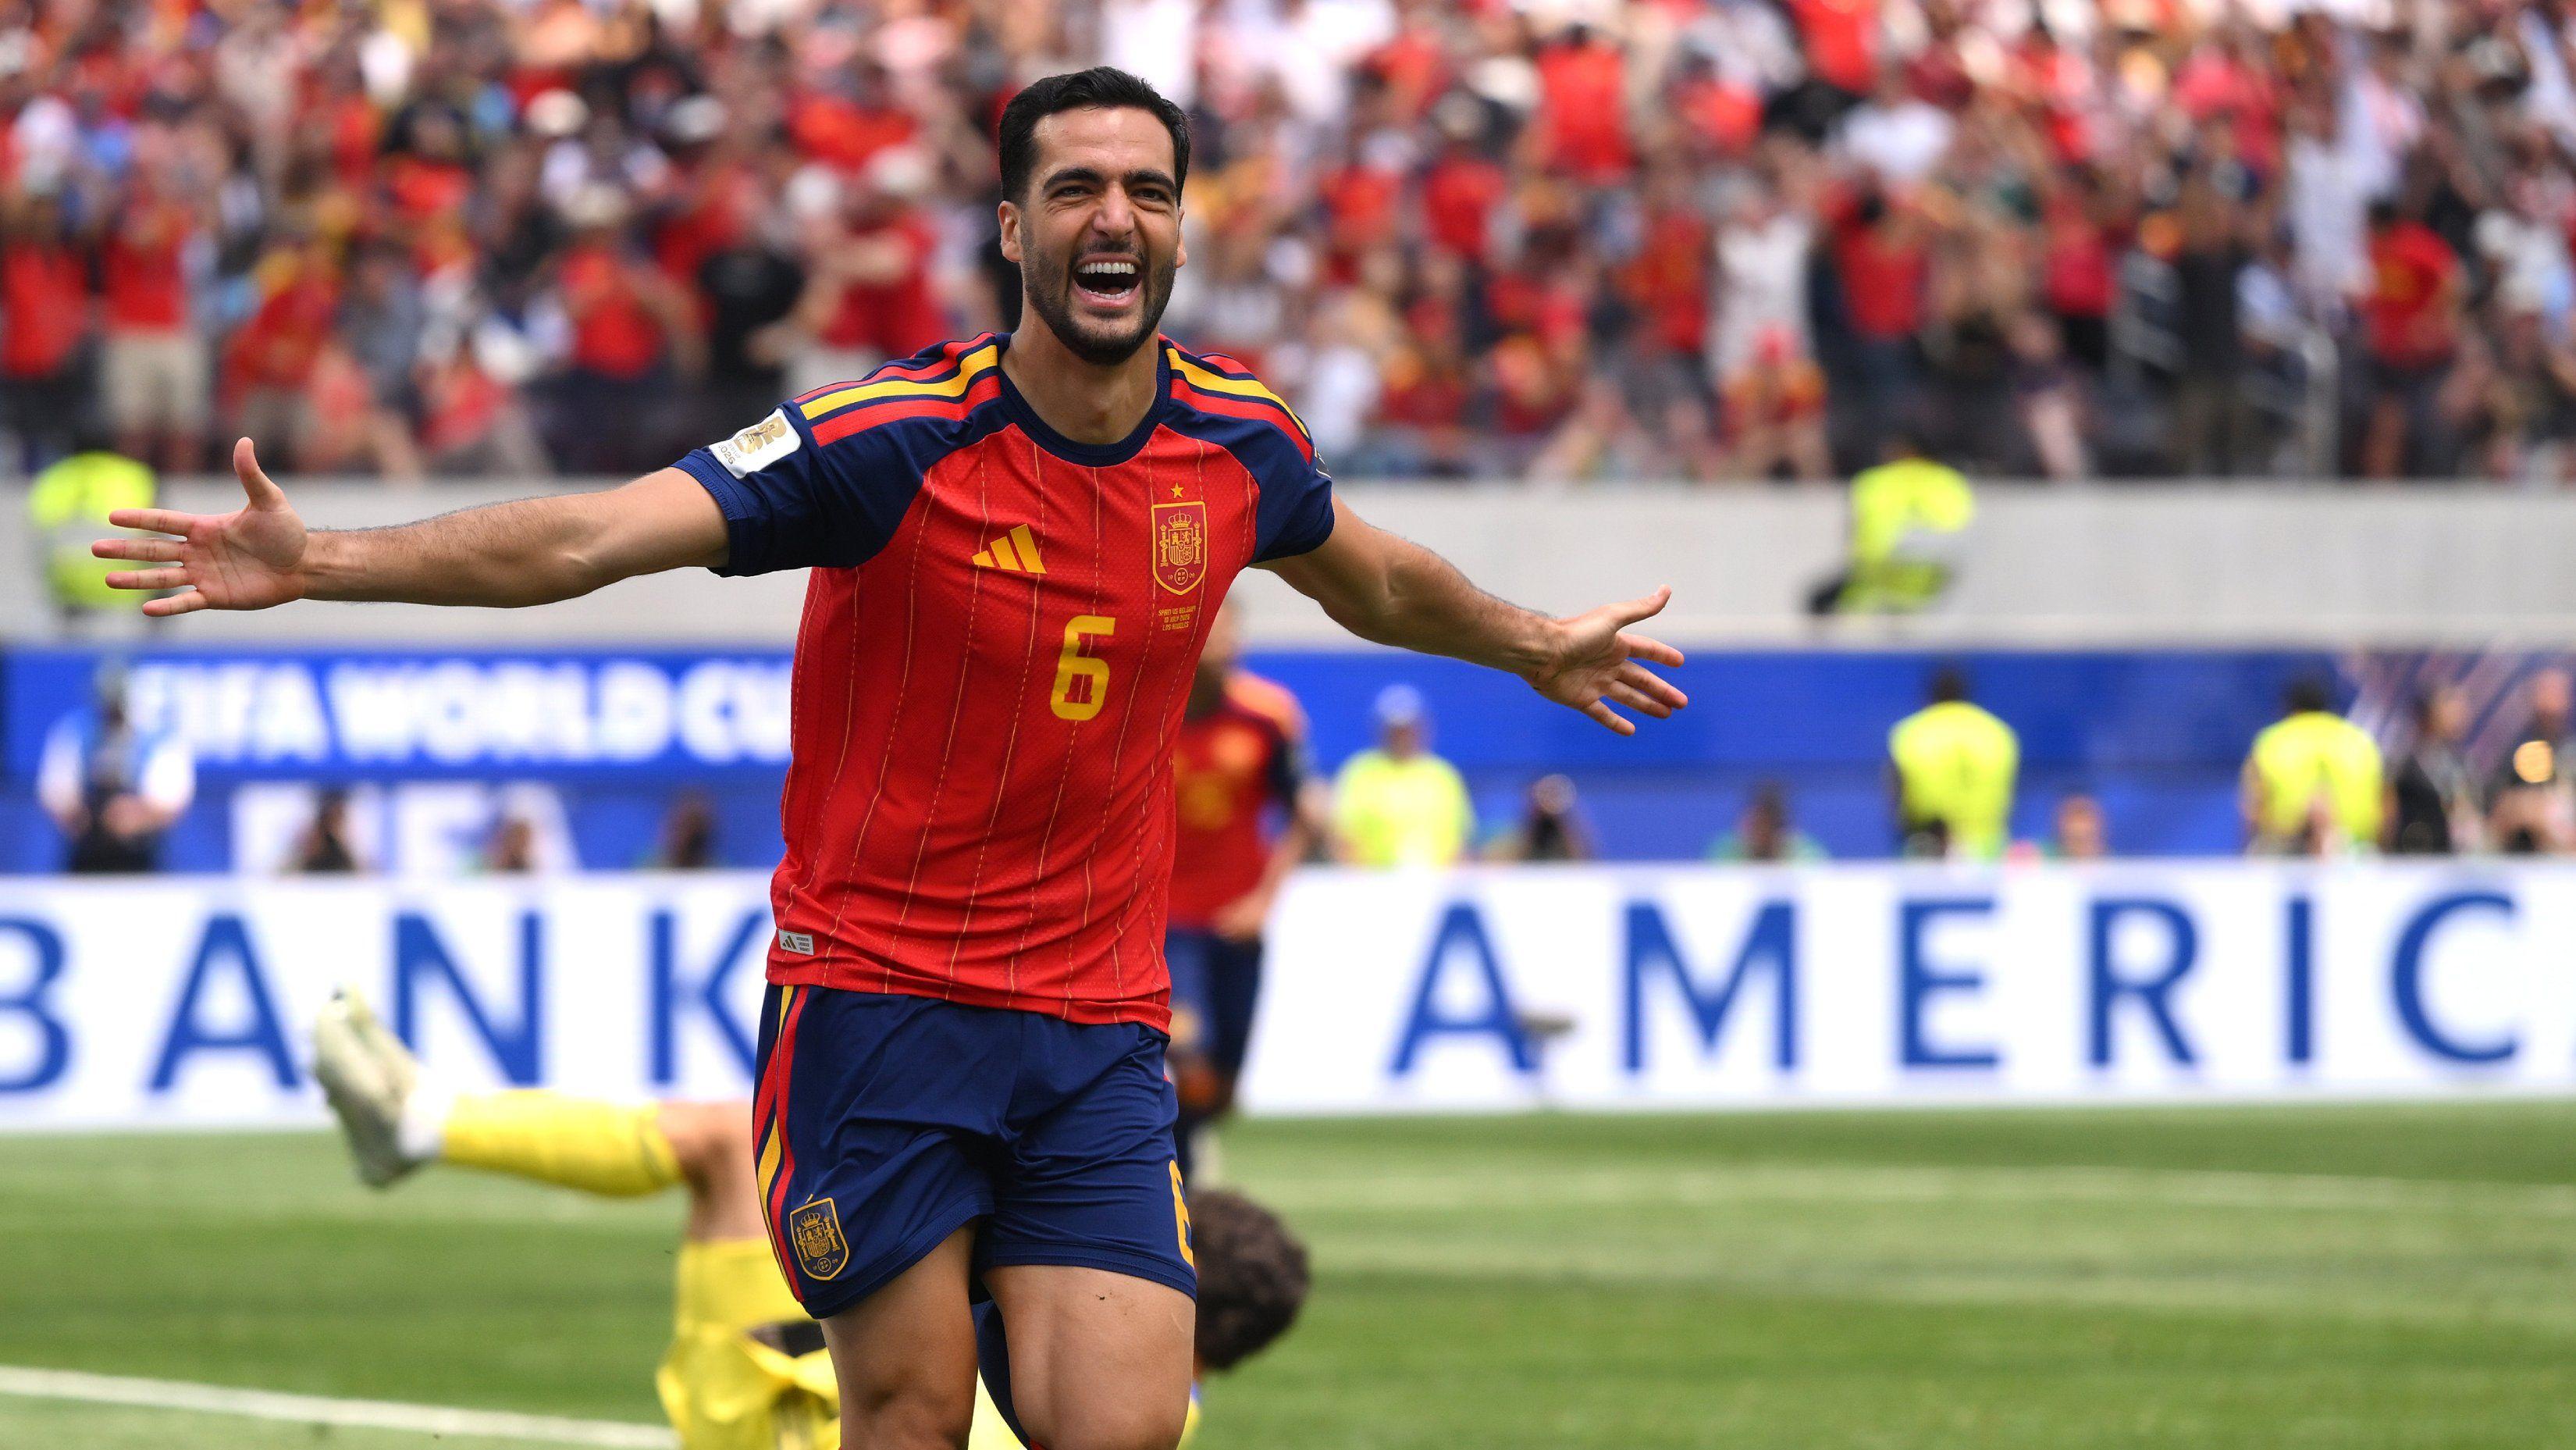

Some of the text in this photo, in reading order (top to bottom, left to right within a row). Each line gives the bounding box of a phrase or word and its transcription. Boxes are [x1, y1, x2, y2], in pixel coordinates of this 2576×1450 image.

[326, 659, 673, 763] WORLD
[1050, 615, 1116, 721] 6
[0, 910, 767, 1092] BANK
